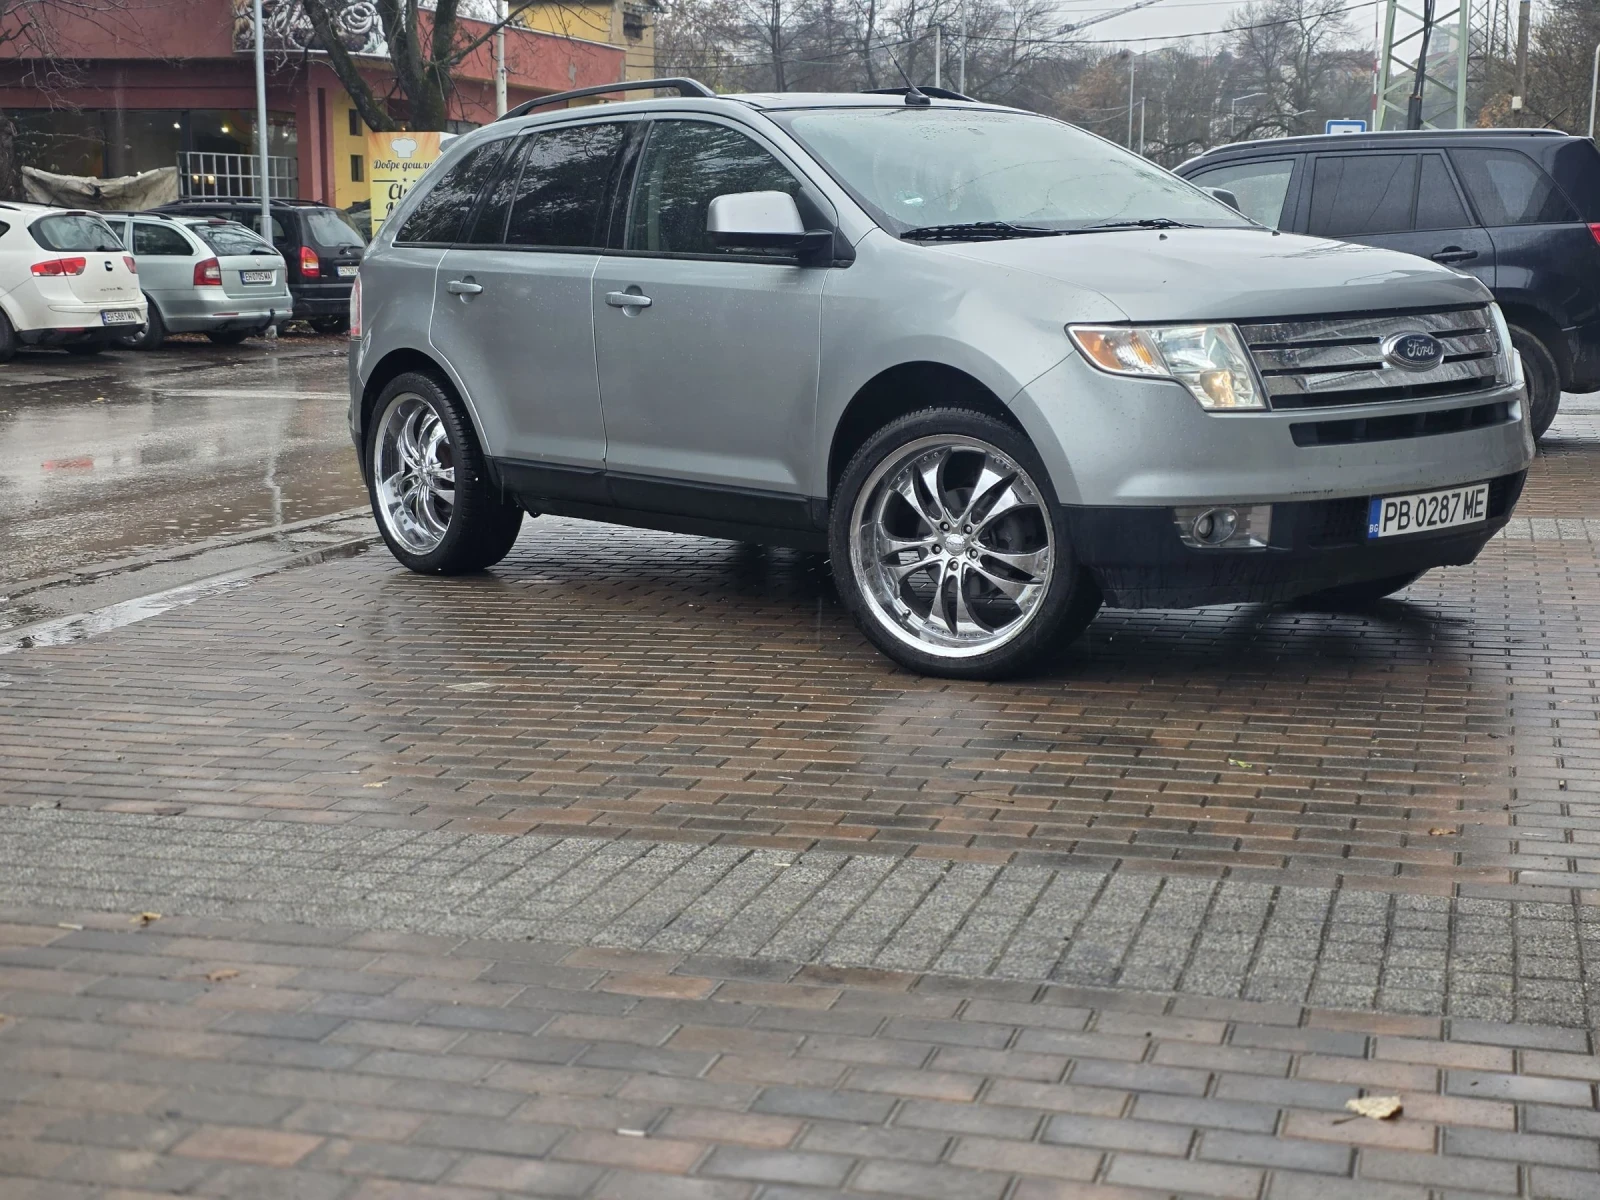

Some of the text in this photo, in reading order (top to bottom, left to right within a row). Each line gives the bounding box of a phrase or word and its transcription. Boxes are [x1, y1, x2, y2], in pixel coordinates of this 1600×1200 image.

[373, 159, 400, 172] Добре
[1407, 339, 1435, 357] Ford
[1383, 488, 1485, 532] PB 0287 ME
[1369, 524, 1379, 533] BG
